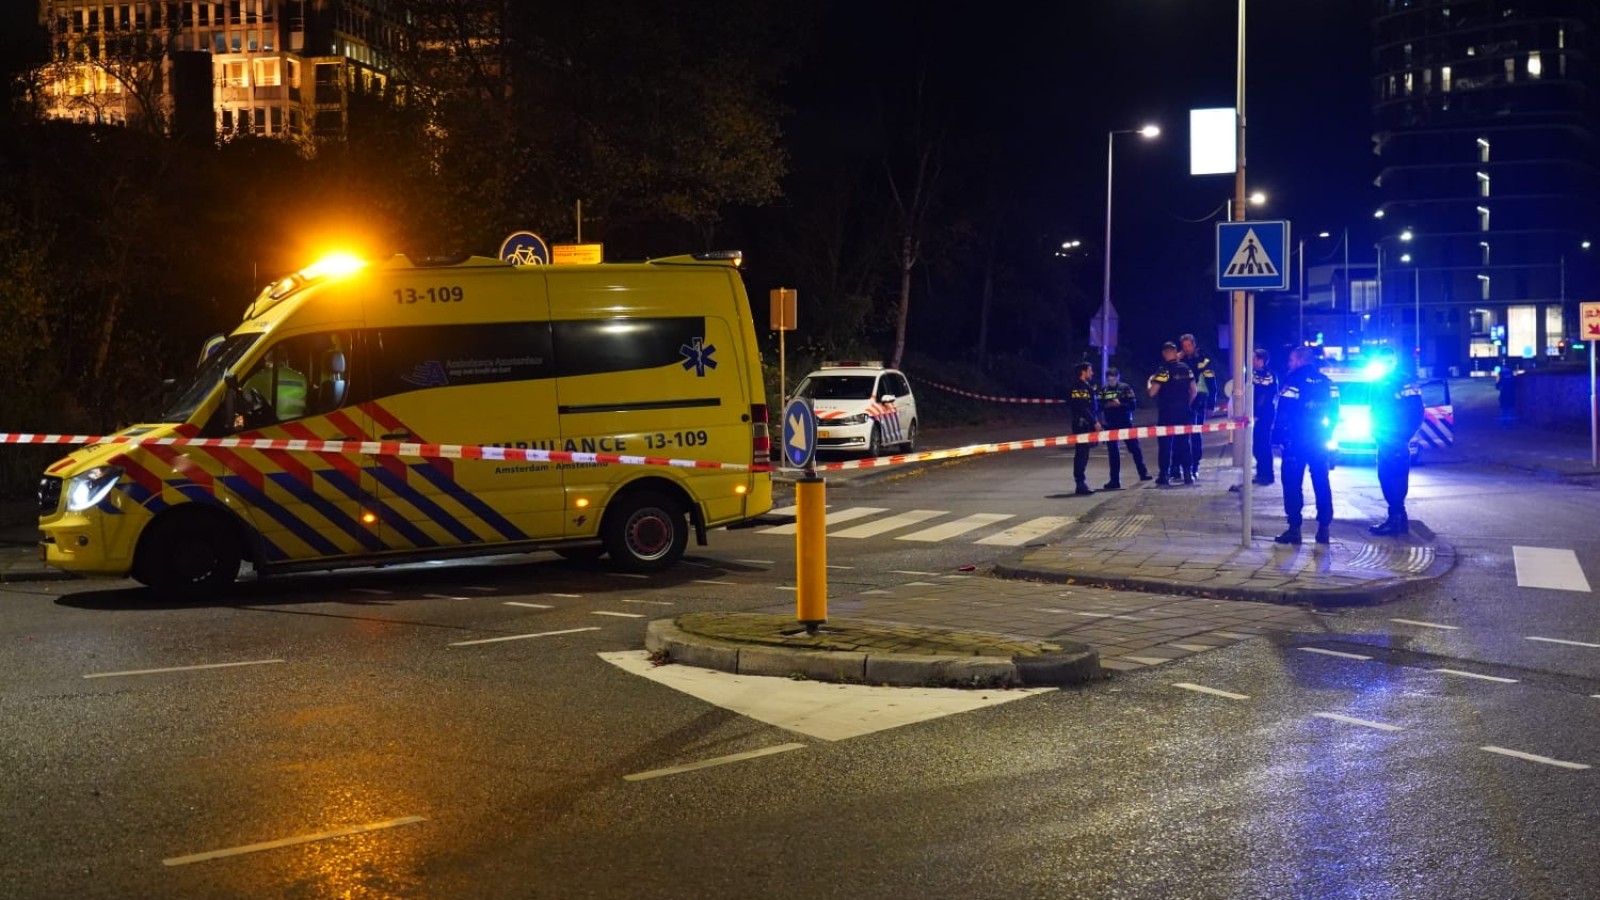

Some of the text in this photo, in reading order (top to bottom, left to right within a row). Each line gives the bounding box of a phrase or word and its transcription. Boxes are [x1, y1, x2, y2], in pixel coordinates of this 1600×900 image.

[393, 286, 464, 304] 13-109
[474, 438, 627, 460] BULANCE
[644, 430, 708, 449] 13-109
[495, 463, 549, 475] Amsterdam
